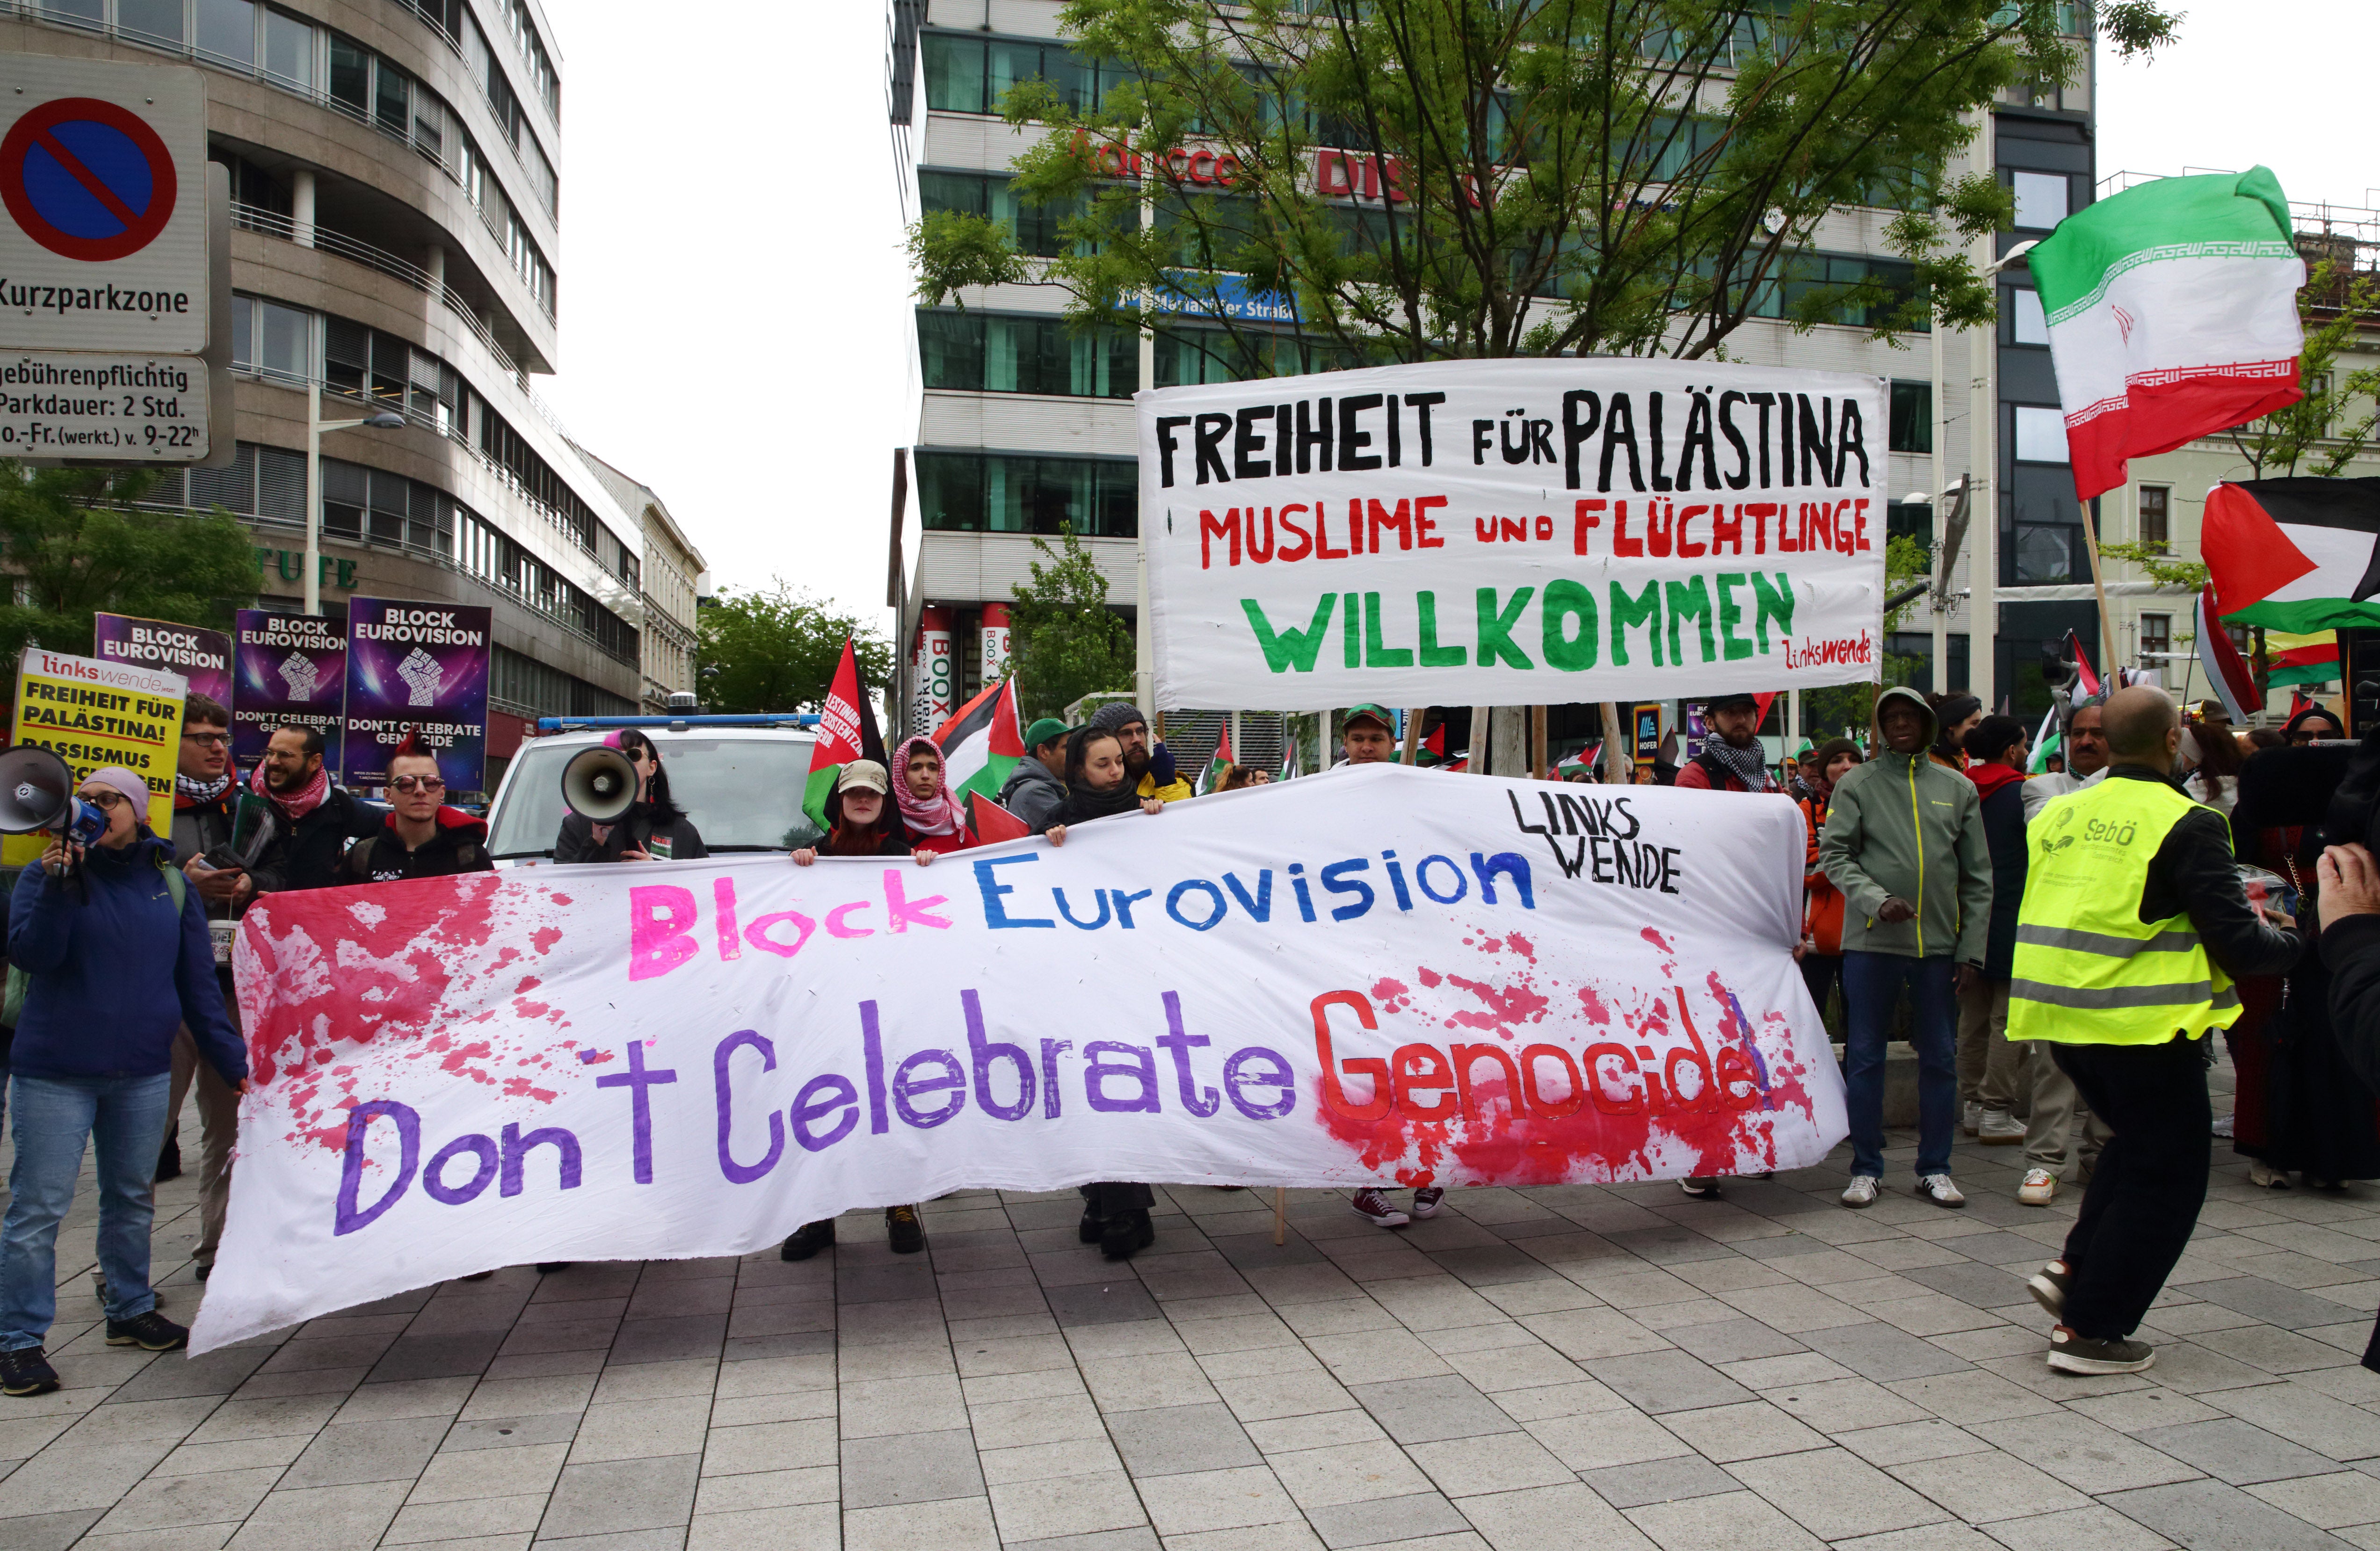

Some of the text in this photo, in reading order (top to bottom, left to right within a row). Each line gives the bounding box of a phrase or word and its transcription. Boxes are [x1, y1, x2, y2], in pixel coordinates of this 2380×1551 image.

[0, 278, 188, 314] Kurzparkzone
[0, 392, 185, 418] Parkdauer: 2 Std.
[2, 423, 55, 443] o.-Fr.
[125, 434, 137, 445] v.
[1155, 384, 1869, 493] FREIHEIT FÜR PALÄSTINA
[1199, 495, 1870, 570] MUSLIME UND FLÜCHTLINGE
[268, 618, 328, 635] BLOCK
[385, 608, 455, 628] BLOCK
[1241, 572, 1795, 674] WILLKOMMEN
[132, 627, 199, 650] BLOCK
[242, 630, 348, 650] EUROVISION
[355, 623, 482, 646] EUROVISION
[987, 631, 995, 666] BOOX
[1782, 628, 1871, 669] linkswende
[103, 639, 225, 669] EUROVISION
[932, 639, 950, 716] BOOX
[26, 681, 175, 720] FREIHEIT FÜR
[23, 706, 166, 741] PALÄSTINA!
[235, 710, 343, 725] DON'T CELEBRAT
[348, 719, 397, 732] DON'T
[377, 733, 453, 747] GENCIDE
[1639, 741, 1657, 750] HOFER
[1508, 789, 1640, 840] LINKS
[652, 835, 671, 846] FREE
[1544, 833, 1681, 894] WENDE
[628, 849, 1536, 982] Block Eurovision
[714, 989, 1296, 1184] Celebrate
